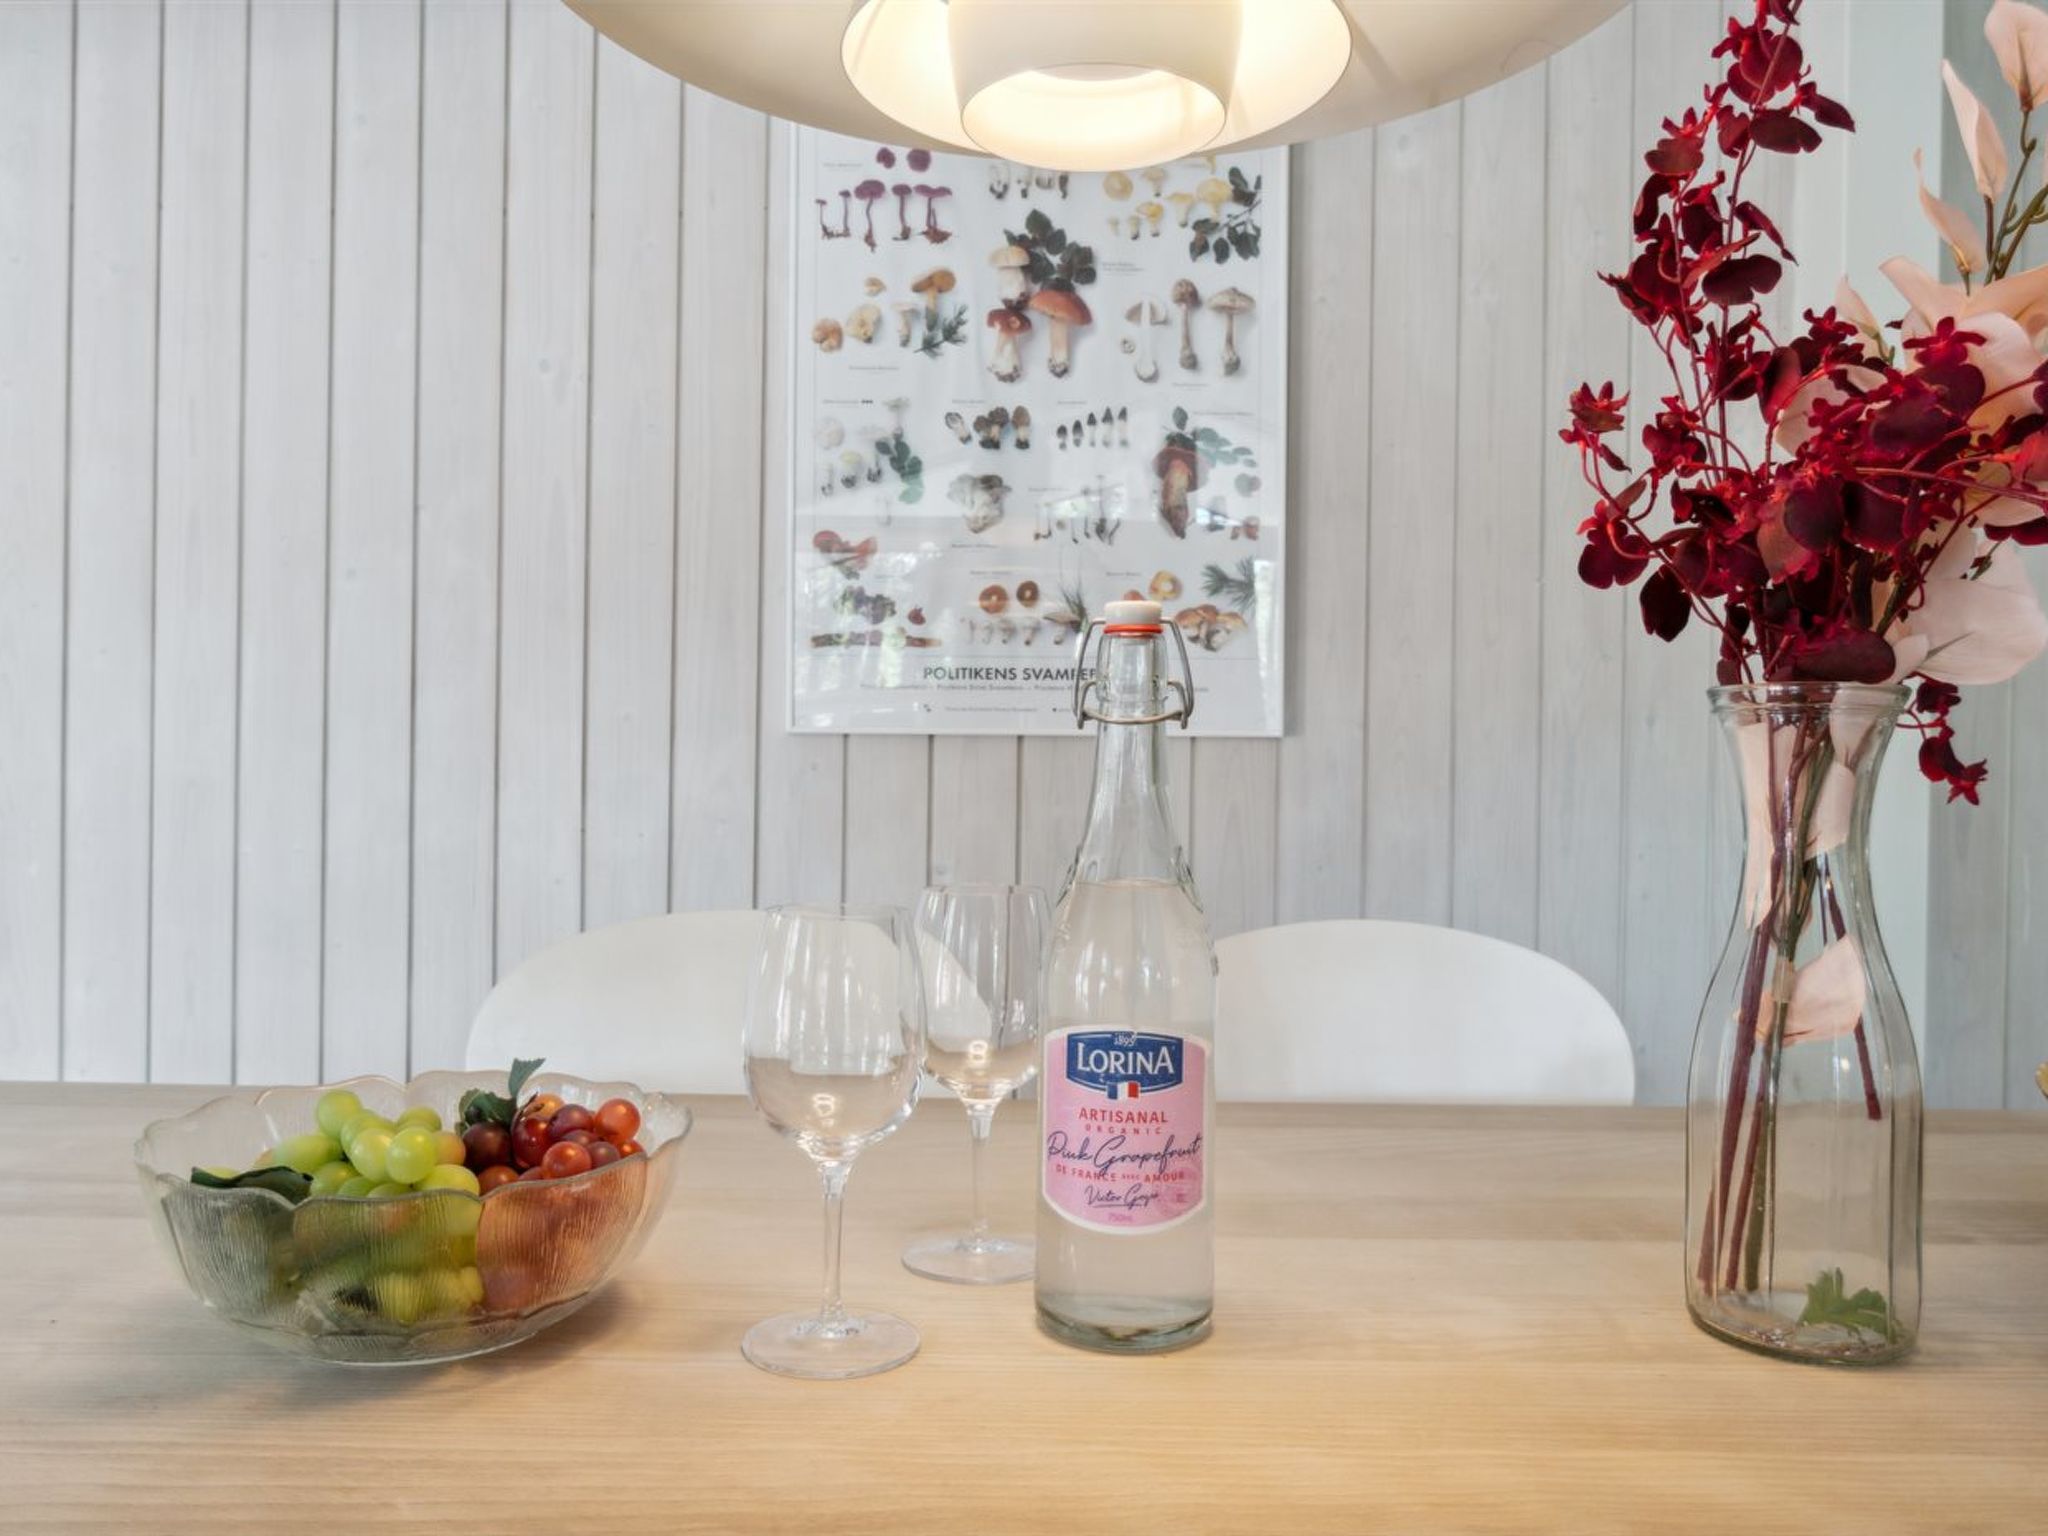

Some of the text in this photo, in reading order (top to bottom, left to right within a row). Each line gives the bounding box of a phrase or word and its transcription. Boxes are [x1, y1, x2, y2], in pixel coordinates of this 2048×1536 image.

[923, 667, 1018, 681] POLITIKENS
[1077, 1042, 1175, 1075] LORINA
[1079, 1107, 1169, 1123] ARTISANAL
[1085, 1123, 1162, 1135] ORGANIC
[1047, 1130, 1202, 1174] Pink Grapefruit
[1055, 1163, 1067, 1174] DE
[1071, 1166, 1117, 1182] FRANCE
[1143, 1171, 1185, 1183] AMOUR
